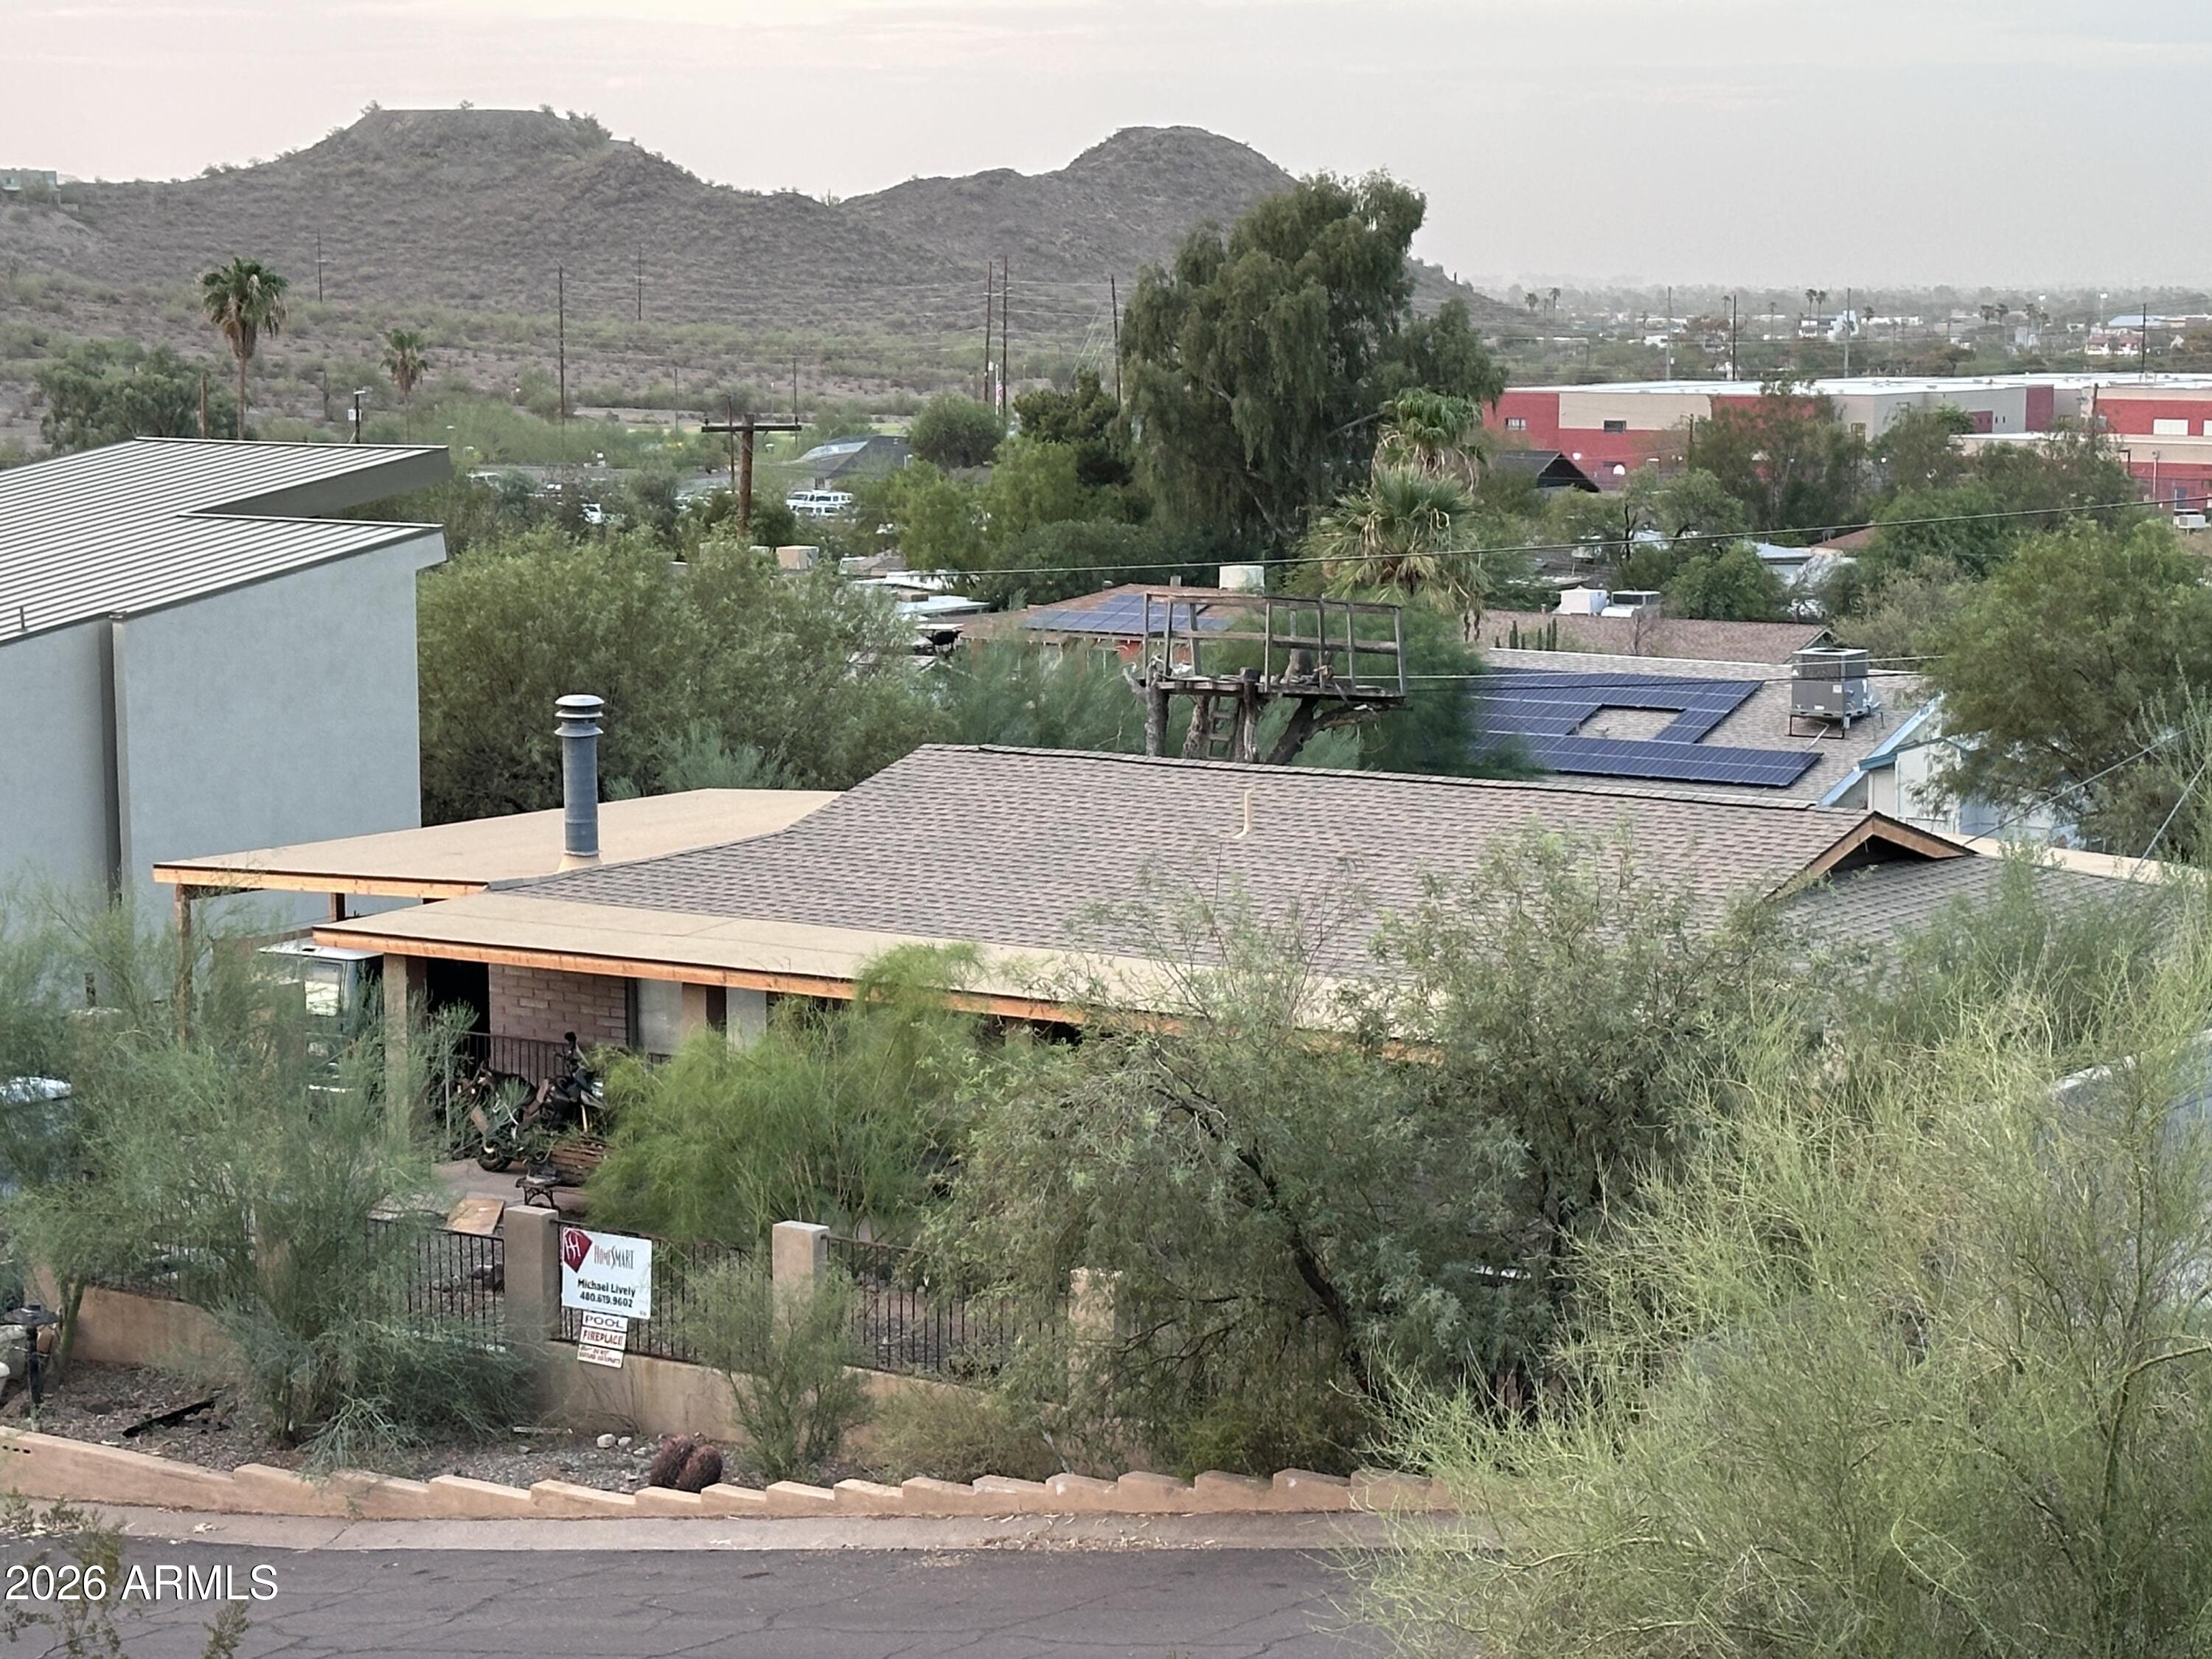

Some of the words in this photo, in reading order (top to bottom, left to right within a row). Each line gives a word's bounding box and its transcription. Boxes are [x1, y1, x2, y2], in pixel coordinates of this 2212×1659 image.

[577, 1278, 609, 1292] Michael
[611, 1283, 636, 1298] Lively
[585, 1315, 624, 1329] POOL
[582, 1329, 623, 1346] FIREPLACE
